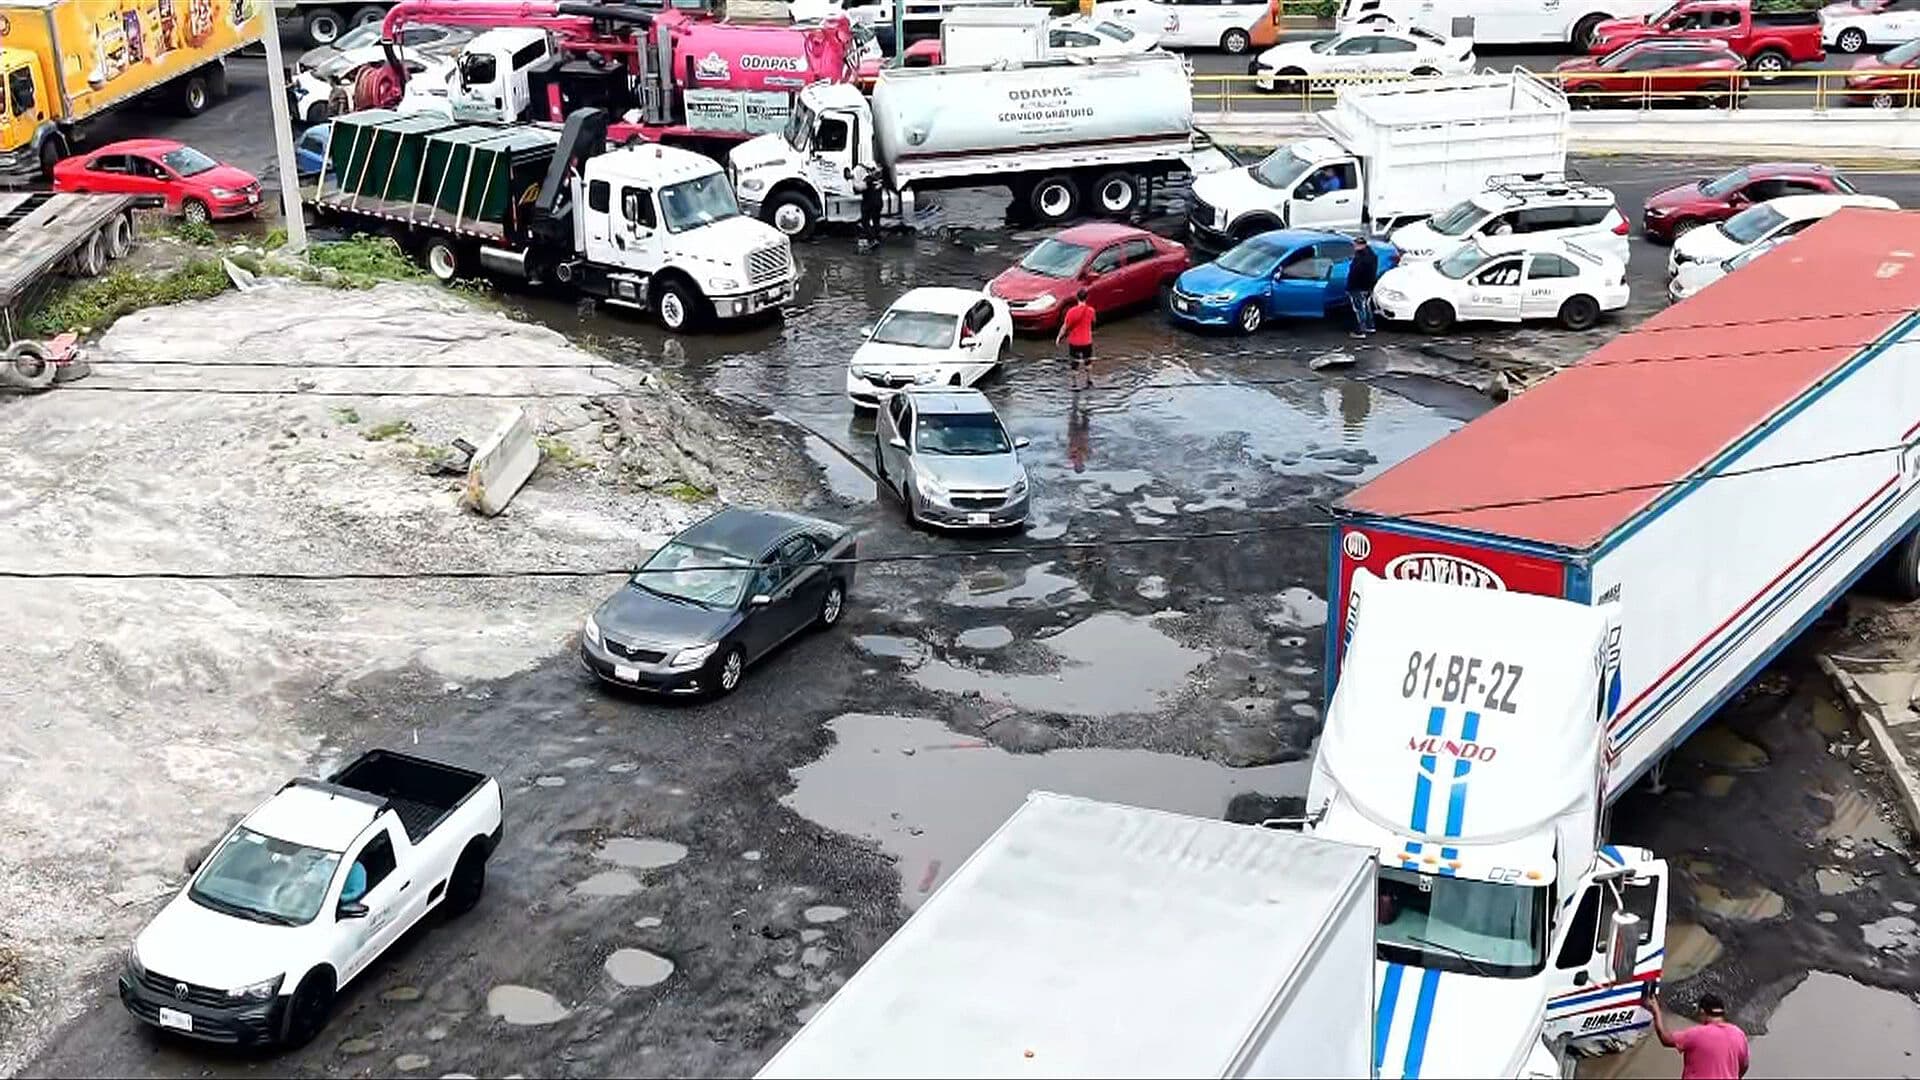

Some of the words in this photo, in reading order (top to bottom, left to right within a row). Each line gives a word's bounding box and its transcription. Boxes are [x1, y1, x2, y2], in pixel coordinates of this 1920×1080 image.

[742, 57, 797, 70] ODAPAS
[1402, 651, 1523, 714] 81-BF-2Z
[1407, 736, 1496, 762] MUNDO
